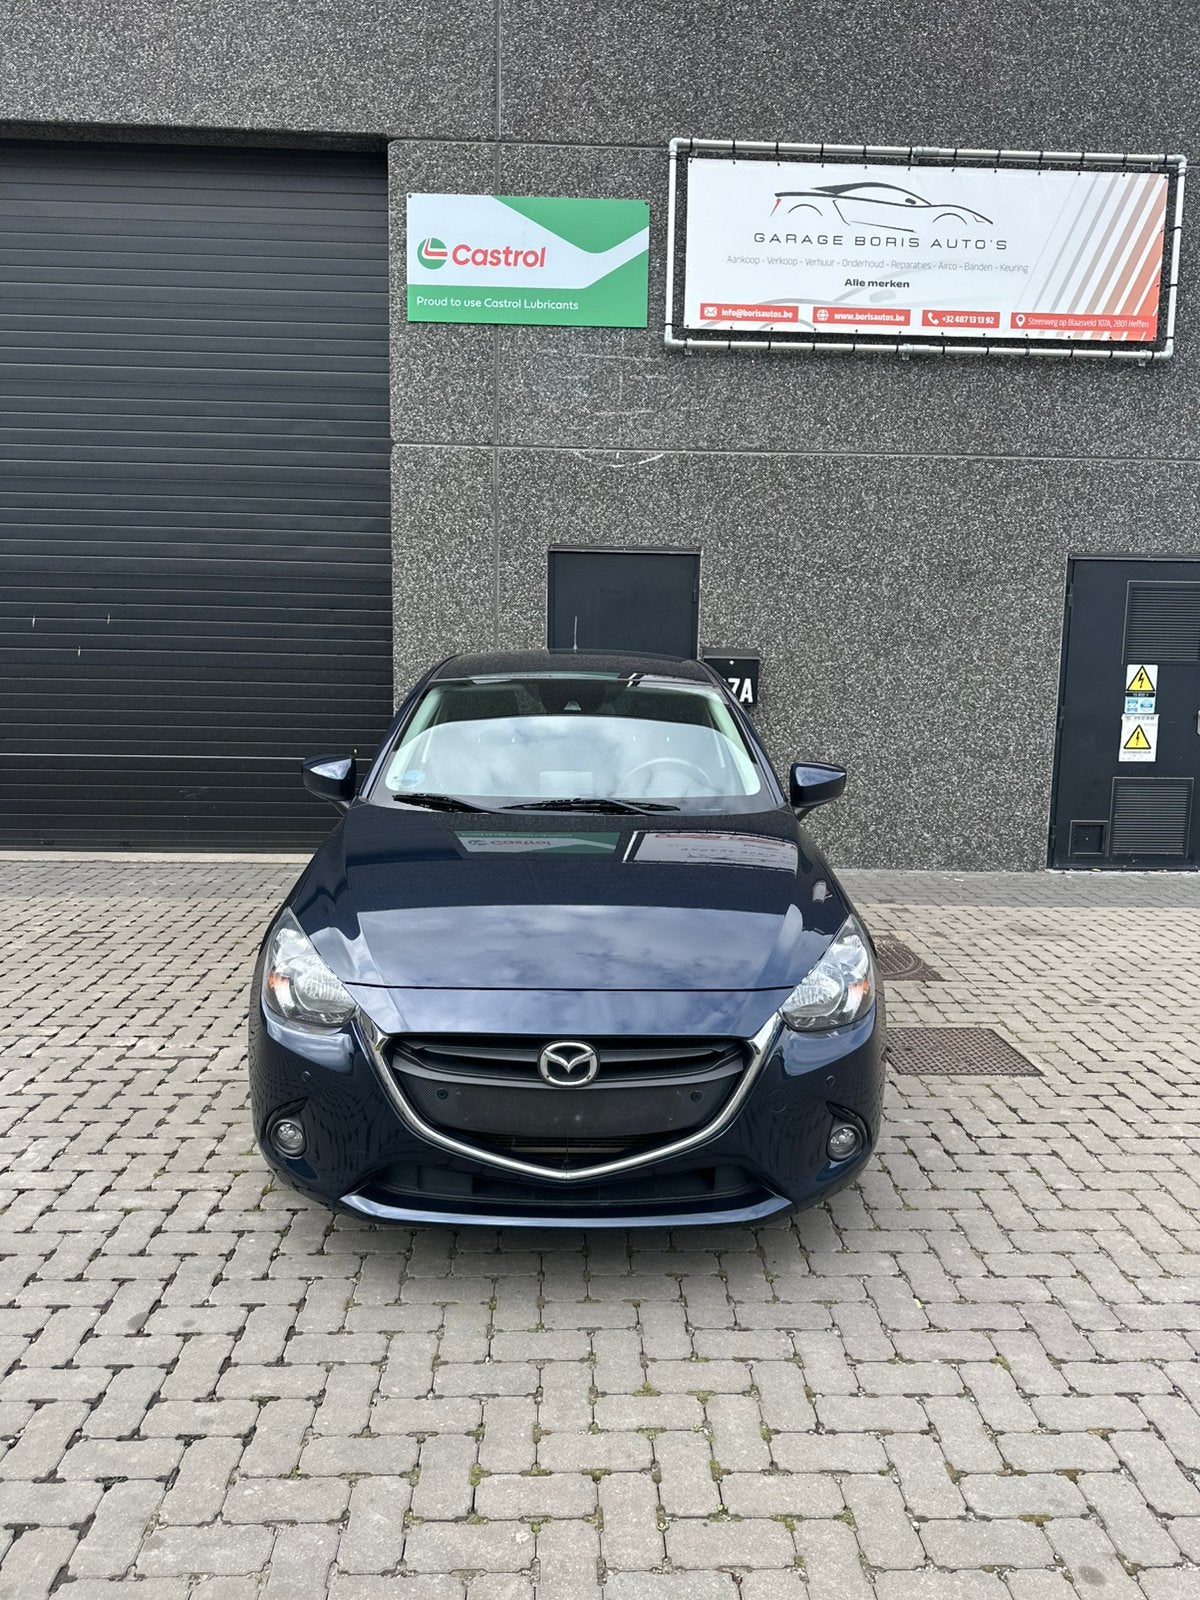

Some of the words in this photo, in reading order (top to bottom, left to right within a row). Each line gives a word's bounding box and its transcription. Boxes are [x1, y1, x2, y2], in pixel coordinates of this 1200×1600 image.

[754, 232, 843, 245] GARAGE
[855, 237, 920, 248] BORIS
[930, 237, 1007, 250] AUTO'S
[452, 244, 546, 267] Castrol
[726, 255, 760, 265] Aankoop
[766, 256, 798, 266] Verkoop
[805, 257, 835, 267] Verhuur
[842, 258, 884, 269] Onderhoud
[891, 259, 932, 270] Reparaties
[938, 261, 958, 270] Airco
[964, 262, 993, 271] Banden
[1000, 263, 1029, 274] Keuring
[844, 278, 866, 287] Alle
[867, 279, 910, 288] merken
[416, 296, 448, 307] Proud
[450, 297, 461, 307] to
[464, 299, 482, 308] use
[484, 298, 522, 309] Castrol
[523, 299, 579, 310] Lubricants
[721, 308, 793, 318] info@borisautos.be
[834, 312, 905, 322] www.borisautos.be
[942, 315, 954, 323] +32
[1028, 317, 1058, 327] Steenweg
[1059, 319, 1066, 328] op
[1128, 319, 1149, 329] Heffen
